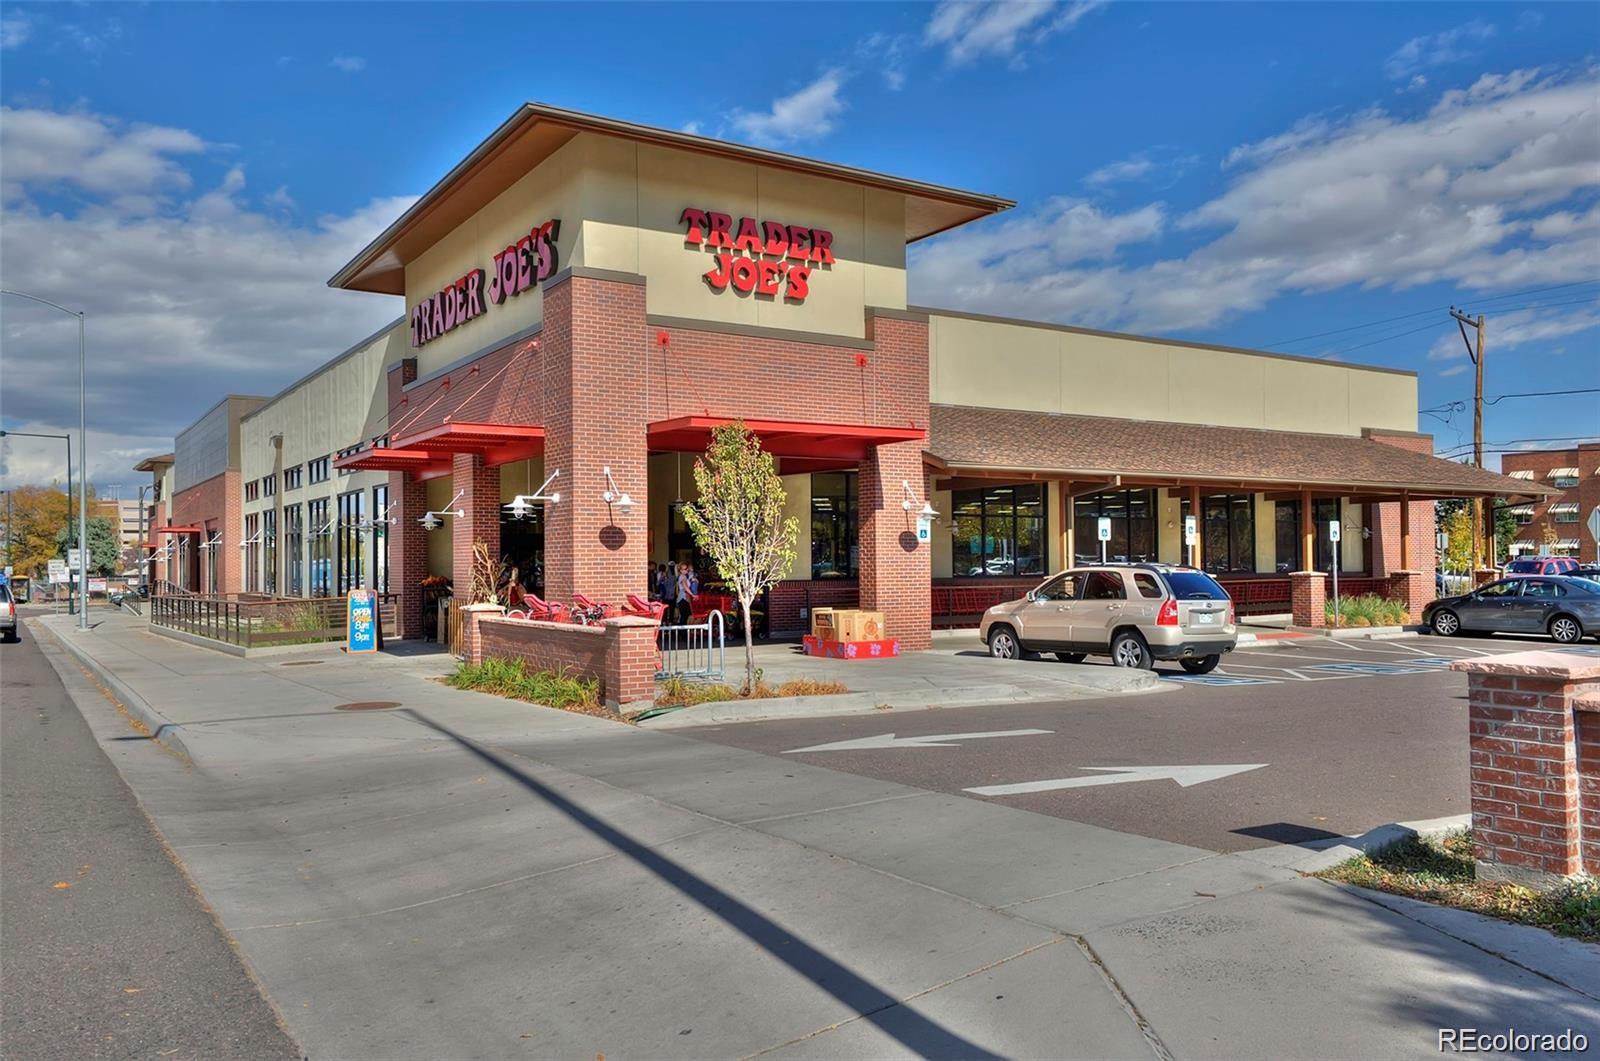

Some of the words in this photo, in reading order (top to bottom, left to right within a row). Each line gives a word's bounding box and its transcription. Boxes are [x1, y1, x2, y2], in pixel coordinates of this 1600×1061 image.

[681, 208, 836, 265] TRADER
[411, 268, 487, 348] TRADER
[488, 219, 561, 305] JOE'S
[702, 253, 812, 303] JOE'S
